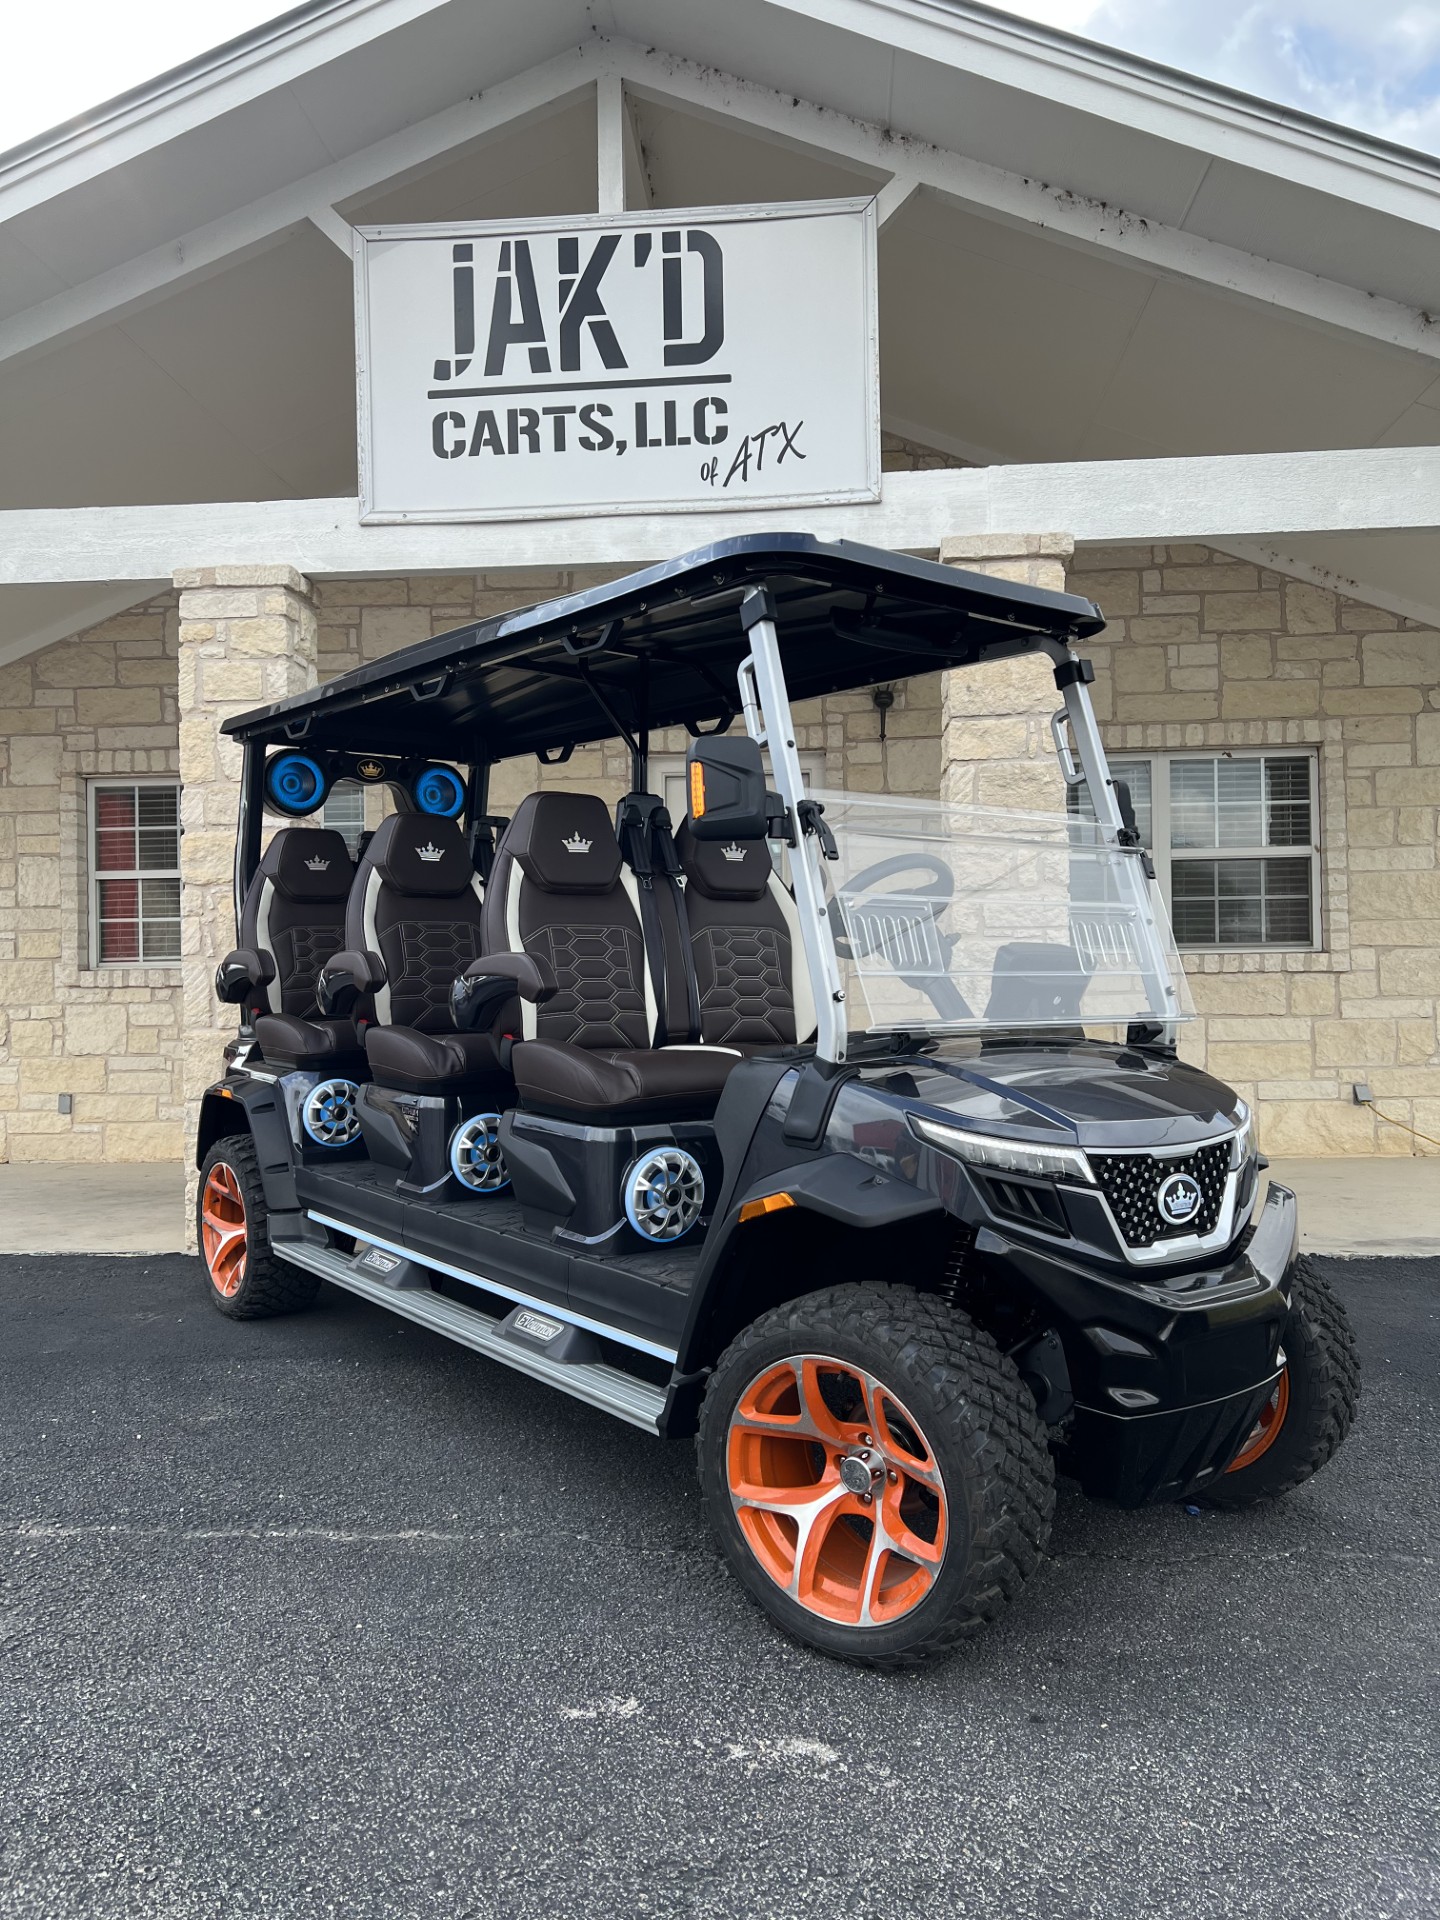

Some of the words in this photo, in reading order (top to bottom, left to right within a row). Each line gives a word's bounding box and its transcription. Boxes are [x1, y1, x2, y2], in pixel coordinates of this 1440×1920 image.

[433, 229, 725, 381] JAK'D
[722, 420, 807, 488] ATX
[517, 1314, 556, 1337] EVOLUTION
